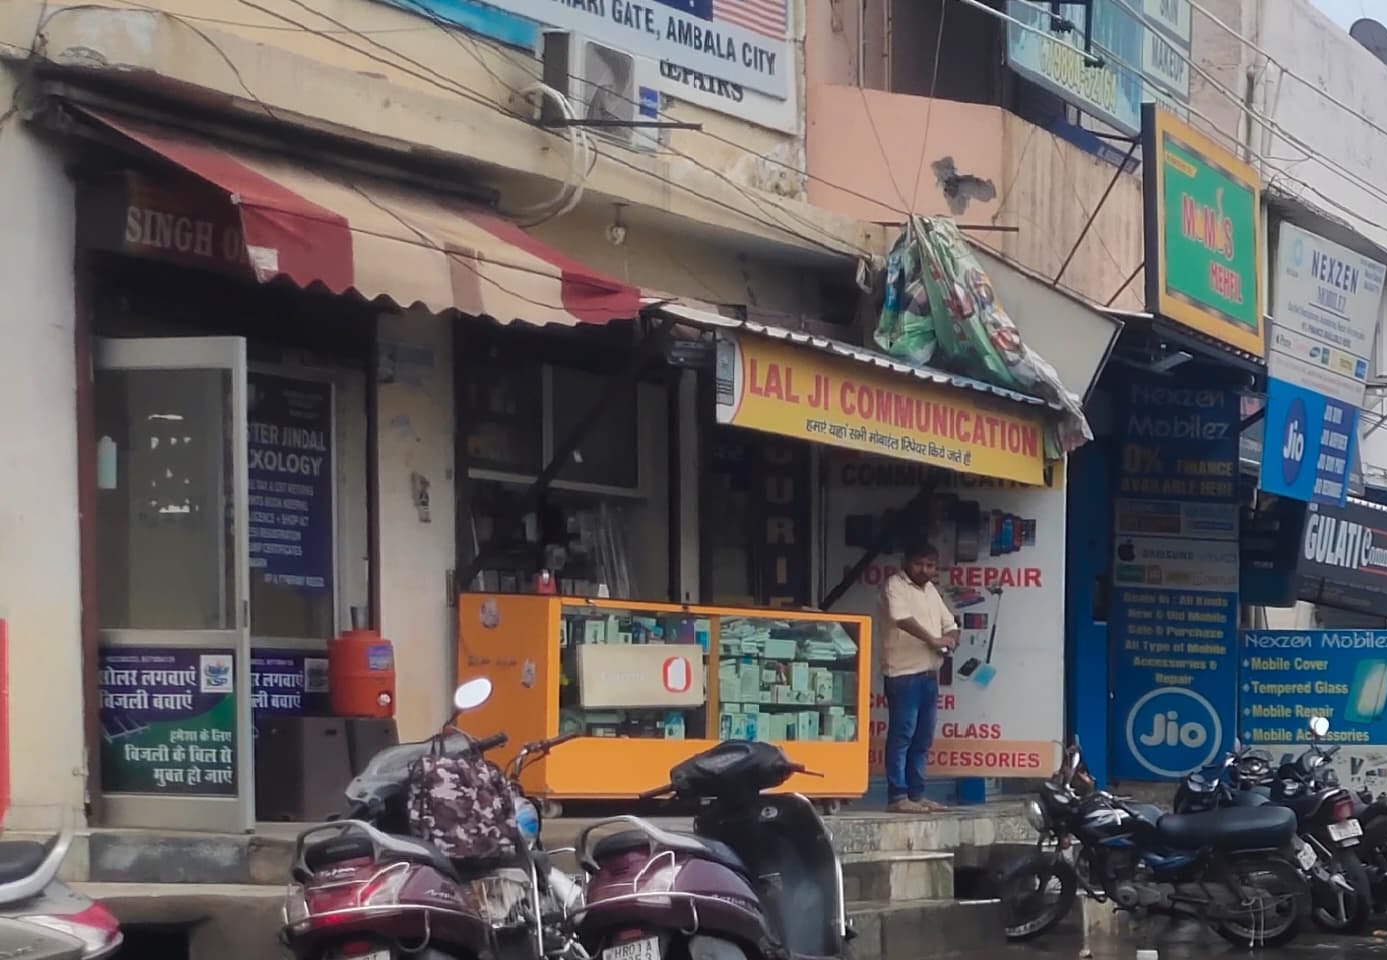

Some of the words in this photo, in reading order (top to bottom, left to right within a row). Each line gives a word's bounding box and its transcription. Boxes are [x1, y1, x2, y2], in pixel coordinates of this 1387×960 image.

[611, 3, 661, 40] GATE,
[666, 16, 736, 63] AMBALA
[742, 42, 776, 76] CITY
[125, 205, 213, 257] SINGH
[1311, 250, 1360, 295] NEXZEN
[750, 358, 799, 404] LAL
[808, 374, 830, 410] JI
[839, 381, 1039, 458] COMMUNICATION
[1127, 414, 1231, 441] Mobilez
[1283, 420, 1304, 462] Jio
[1304, 514, 1363, 570] GULATI
[951, 566, 1042, 588] REPAIR
[1244, 633, 1312, 648] Nexzen
[1251, 658, 1291, 670] Mobile
[1294, 657, 1329, 671] Cover
[142, 665, 197, 687] लगवाएं
[1251, 681, 1312, 696] Tempered
[1314, 681, 1349, 694] Glass
[1252, 705, 1292, 717] Mobile
[1295, 704, 1336, 719] Repair
[942, 721, 1001, 739] GLASS
[1139, 710, 1207, 748] Jio
[1252, 729, 1293, 742] Mobile
[125, 744, 169, 763] बिजली
[172, 744, 187, 763] के
[190, 744, 213, 763] बिल
[215, 744, 232, 764] से
[925, 751, 1040, 769] CCESSORIES
